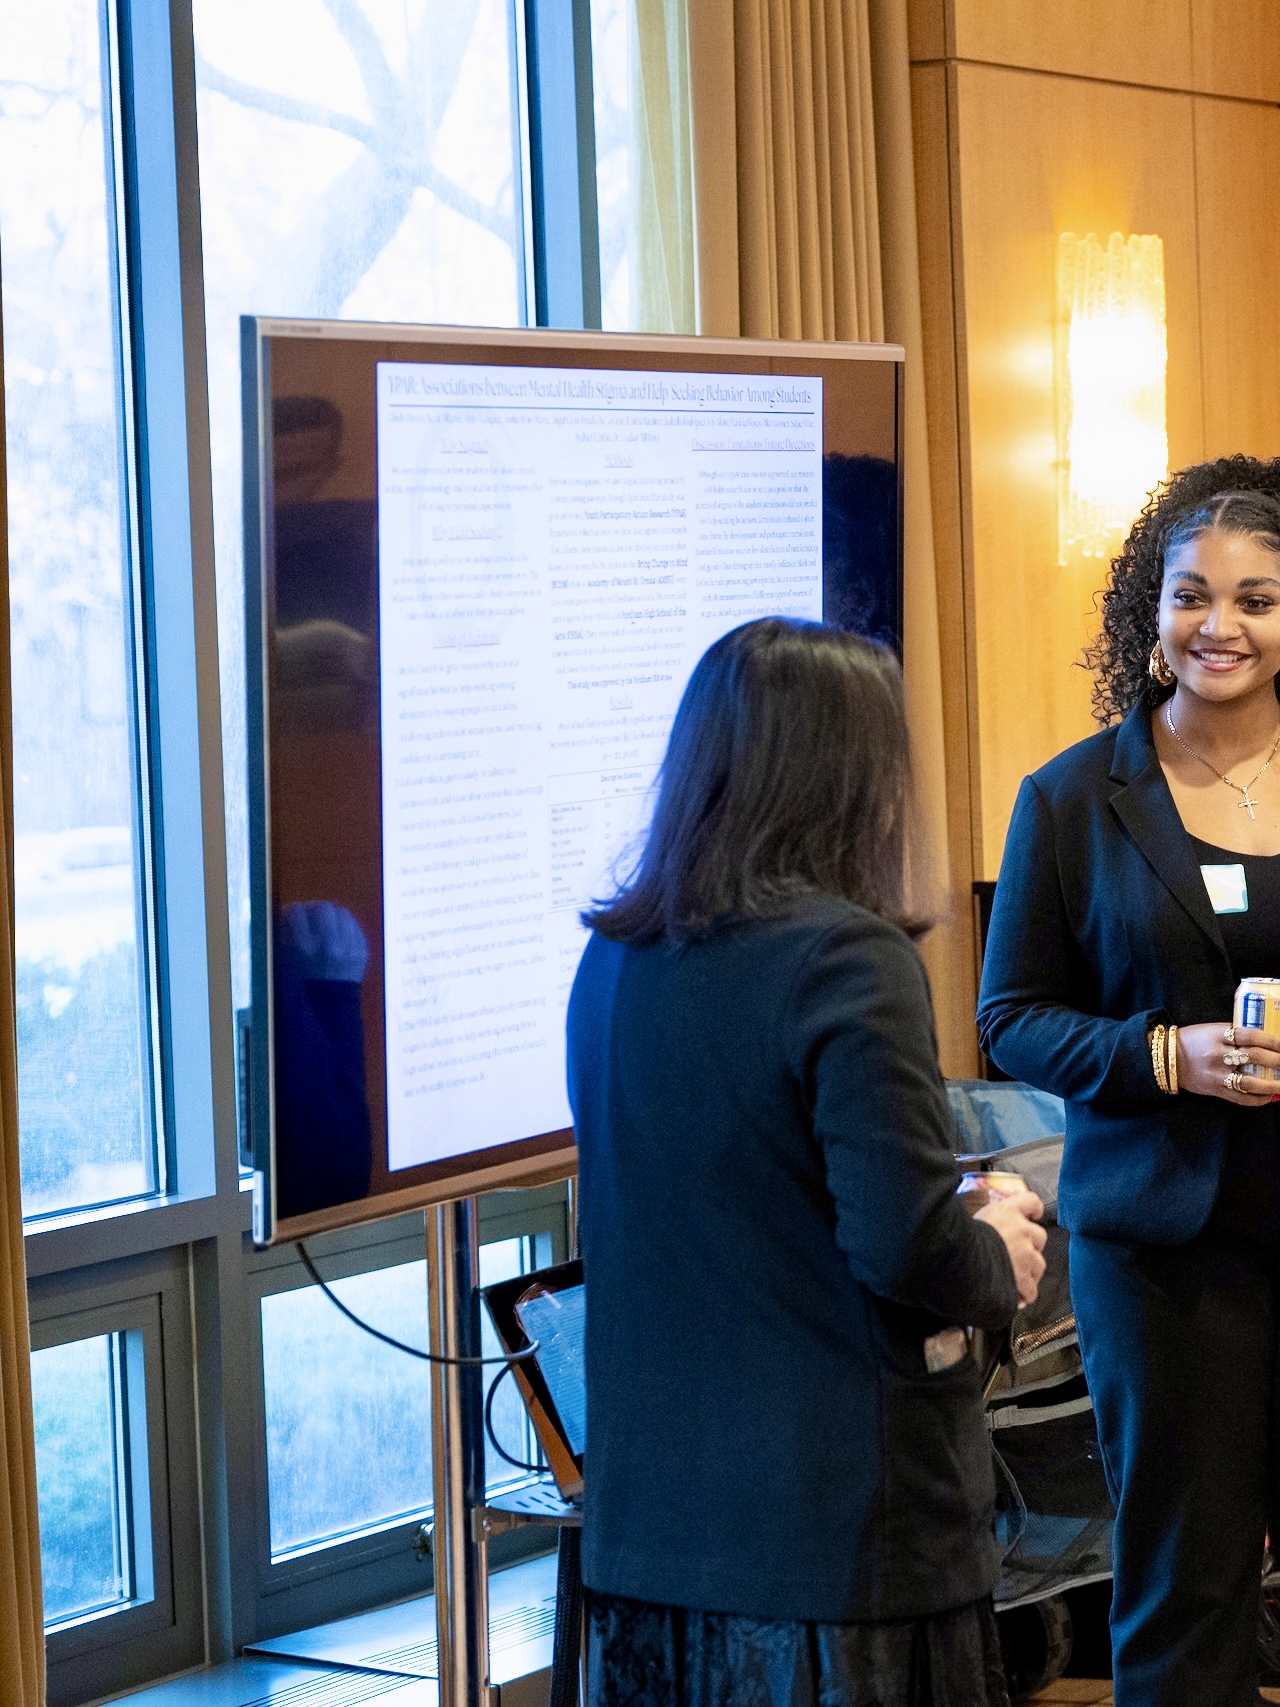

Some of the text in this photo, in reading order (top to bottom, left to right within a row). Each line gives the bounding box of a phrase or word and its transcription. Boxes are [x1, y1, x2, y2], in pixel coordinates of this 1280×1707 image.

[388, 375, 418, 394] YPAR:
[421, 376, 484, 396] Associations
[485, 376, 527, 397] between
[528, 378, 561, 398] Mental
[563, 378, 594, 399] Health
[596, 380, 627, 405] Stigma
[628, 380, 646, 400] and
[706, 384, 744, 402] Behavior
[747, 385, 776, 408] Among
[776, 386, 812, 404] Students
[786, 438, 815, 450] Directions
[649, 509, 670, 518] Research
[656, 607, 672, 617] School
